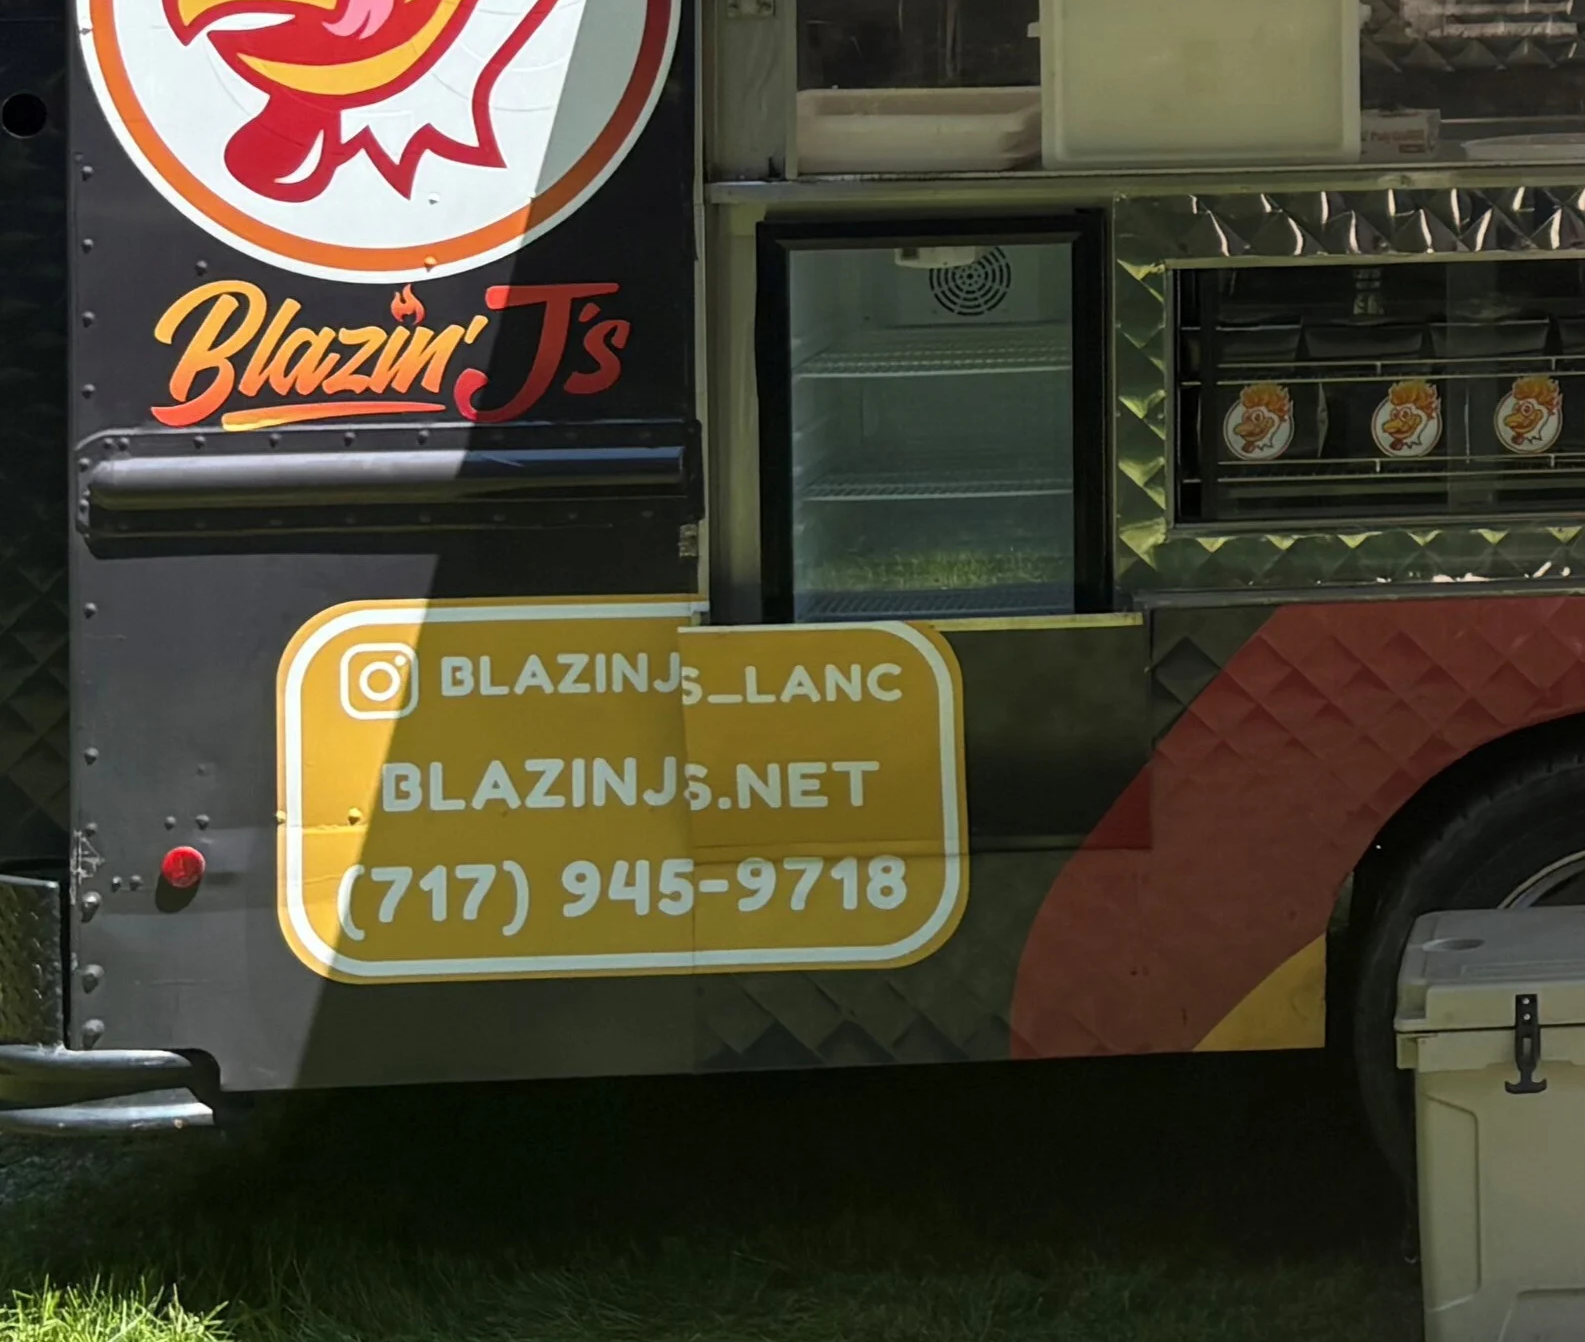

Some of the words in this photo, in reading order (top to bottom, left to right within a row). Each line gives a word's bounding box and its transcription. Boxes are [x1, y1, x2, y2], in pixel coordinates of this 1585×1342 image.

[151, 278, 489, 427] Blazin'
[452, 283, 631, 422] J's
[440, 652, 902, 706] BLAZINJS_LANC
[380, 756, 879, 813] BLAZINJS.NET
[336, 860, 530, 941] (717)
[561, 858, 908, 918] 945-9718
